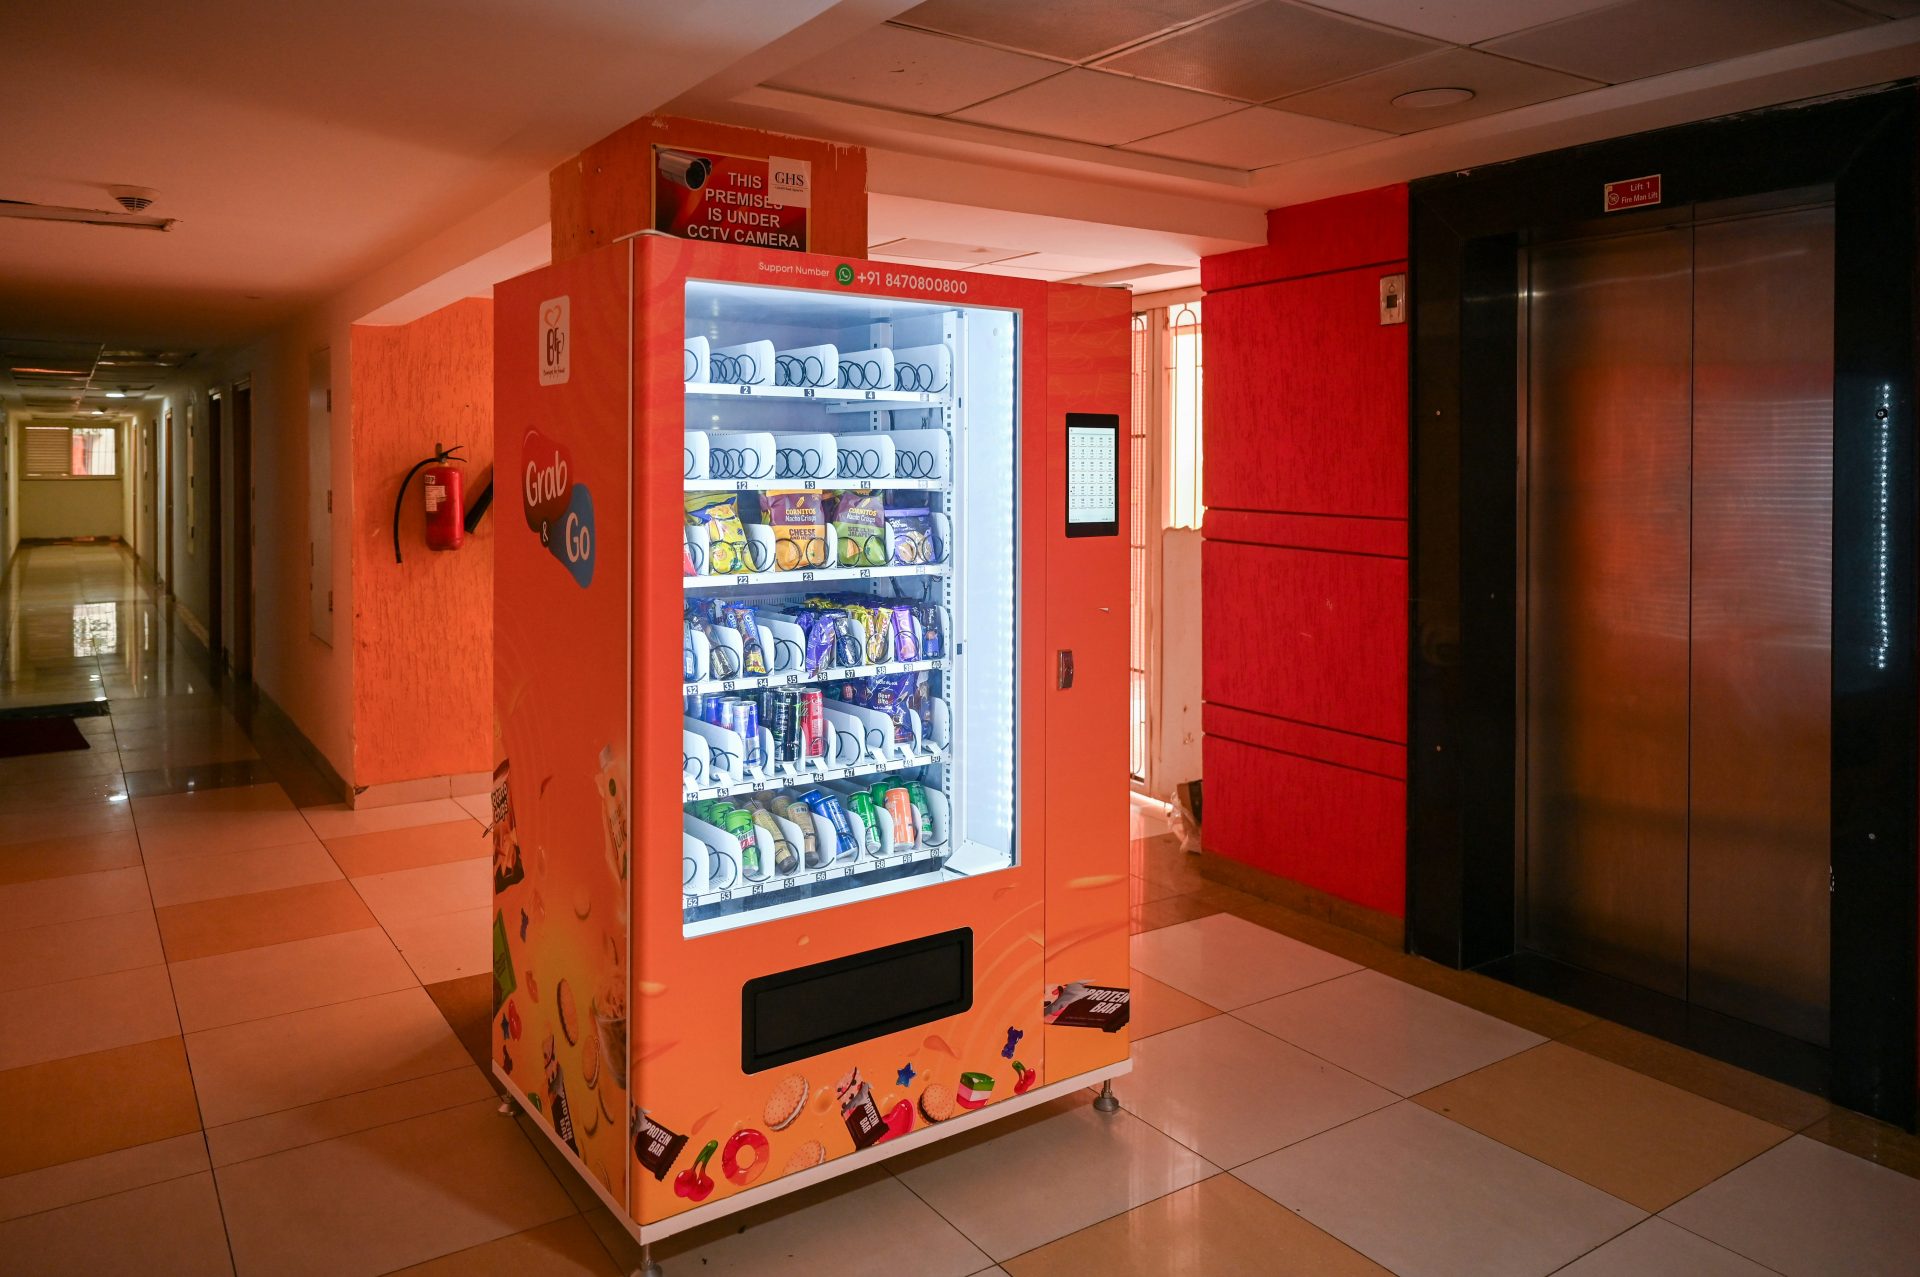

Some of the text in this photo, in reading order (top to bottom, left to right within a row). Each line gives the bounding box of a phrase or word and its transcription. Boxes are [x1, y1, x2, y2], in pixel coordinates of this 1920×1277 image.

[728, 172, 762, 189] THIS
[774, 171, 804, 187] GHS
[1630, 181, 1650, 192] Lift 1
[1621, 196, 1633, 204] Fire
[1633, 194, 1647, 202] Man
[708, 207, 780, 228] IS UNDER
[687, 224, 800, 249] CCTV CAMERA
[758, 262, 968, 295] Support Number +91 8470800800
[526, 450, 568, 507] Grab
[737, 481, 747, 490] 12
[805, 481, 815, 489] 13
[861, 481, 870, 489] 14
[542, 521, 549, 542] &
[565, 512, 590, 563] Go
[803, 572, 813, 580] 23
[861, 569, 870, 577] 24
[737, 576, 748, 585] 22
[845, 670, 855, 678] 37
[877, 666, 886, 674] 38
[723, 682, 734, 690] 33
[758, 679, 768, 687] 34
[687, 686, 698, 694] 32
[844, 769, 855, 777] 47
[687, 793, 698, 801] 42
[816, 872, 826, 880] 56
[784, 879, 794, 887] 55
[753, 886, 763, 894] 54
[721, 892, 731, 900] 53
[687, 898, 698, 906] 52
[1087, 988, 1130, 1003] PROTEIN
[1088, 1002, 1122, 1014] BAR
[561, 1090, 573, 1140] PROTEIN
[864, 1097, 880, 1127] PROTEIN
[860, 1116, 872, 1134] BAR
[645, 1122, 673, 1146] PROTEIN
[647, 1140, 665, 1157] BAR
